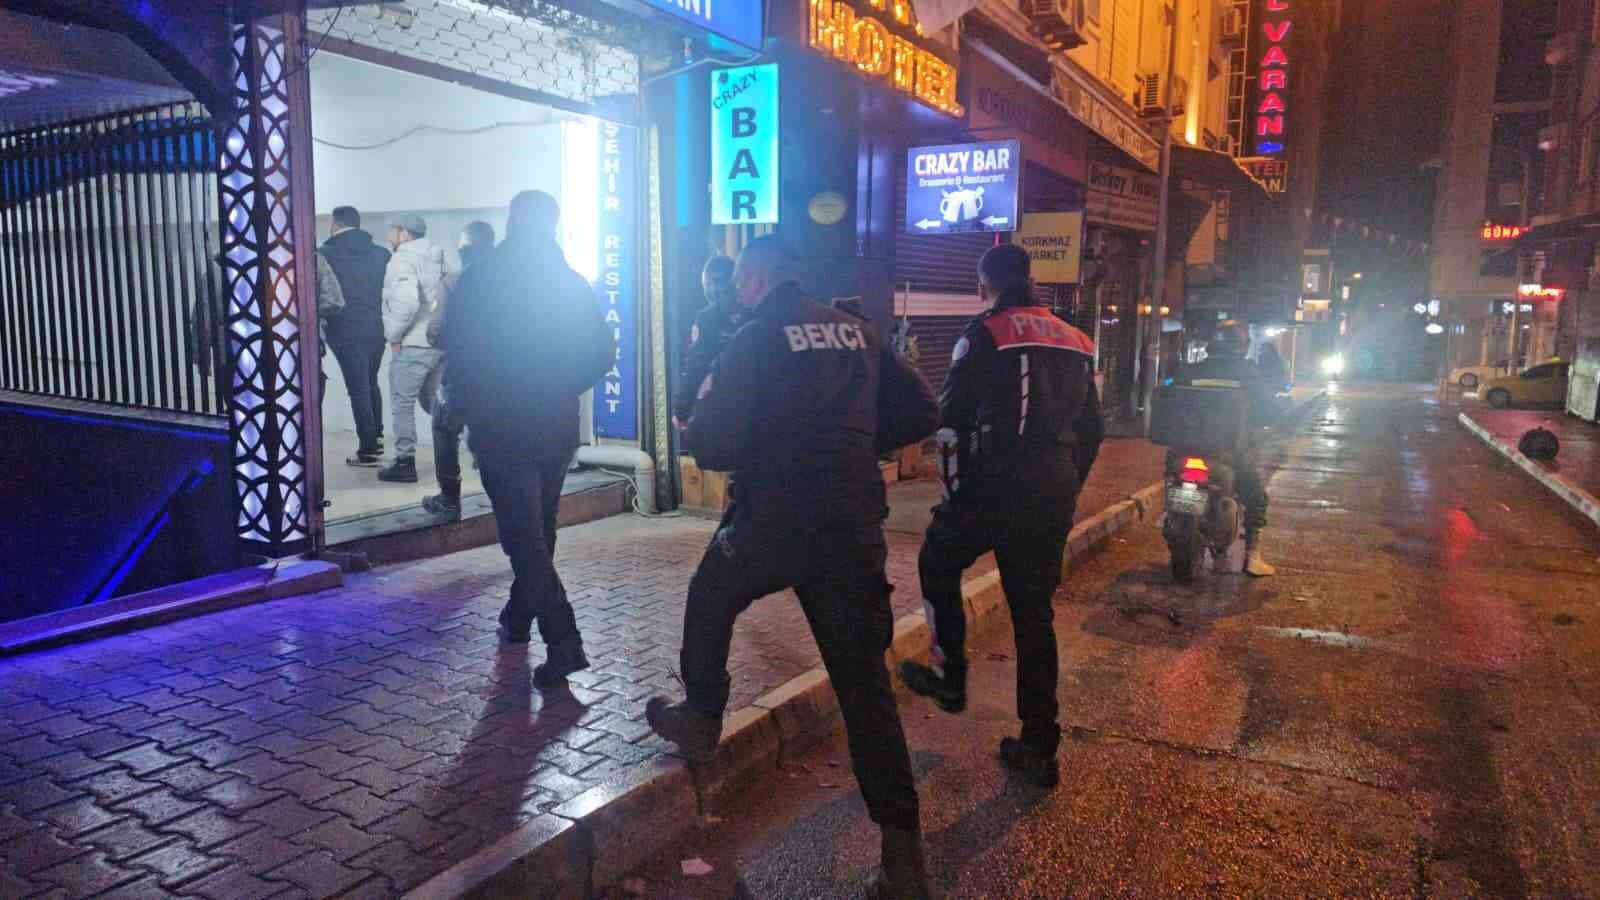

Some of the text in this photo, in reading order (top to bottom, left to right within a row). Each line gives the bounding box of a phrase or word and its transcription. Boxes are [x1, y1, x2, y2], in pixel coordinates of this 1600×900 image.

[712, 68, 758, 110] CRAZY
[728, 107, 760, 220] BAR
[915, 148, 1010, 176] CRAZY BAR
[1022, 235, 1072, 248] KORKMAZ
